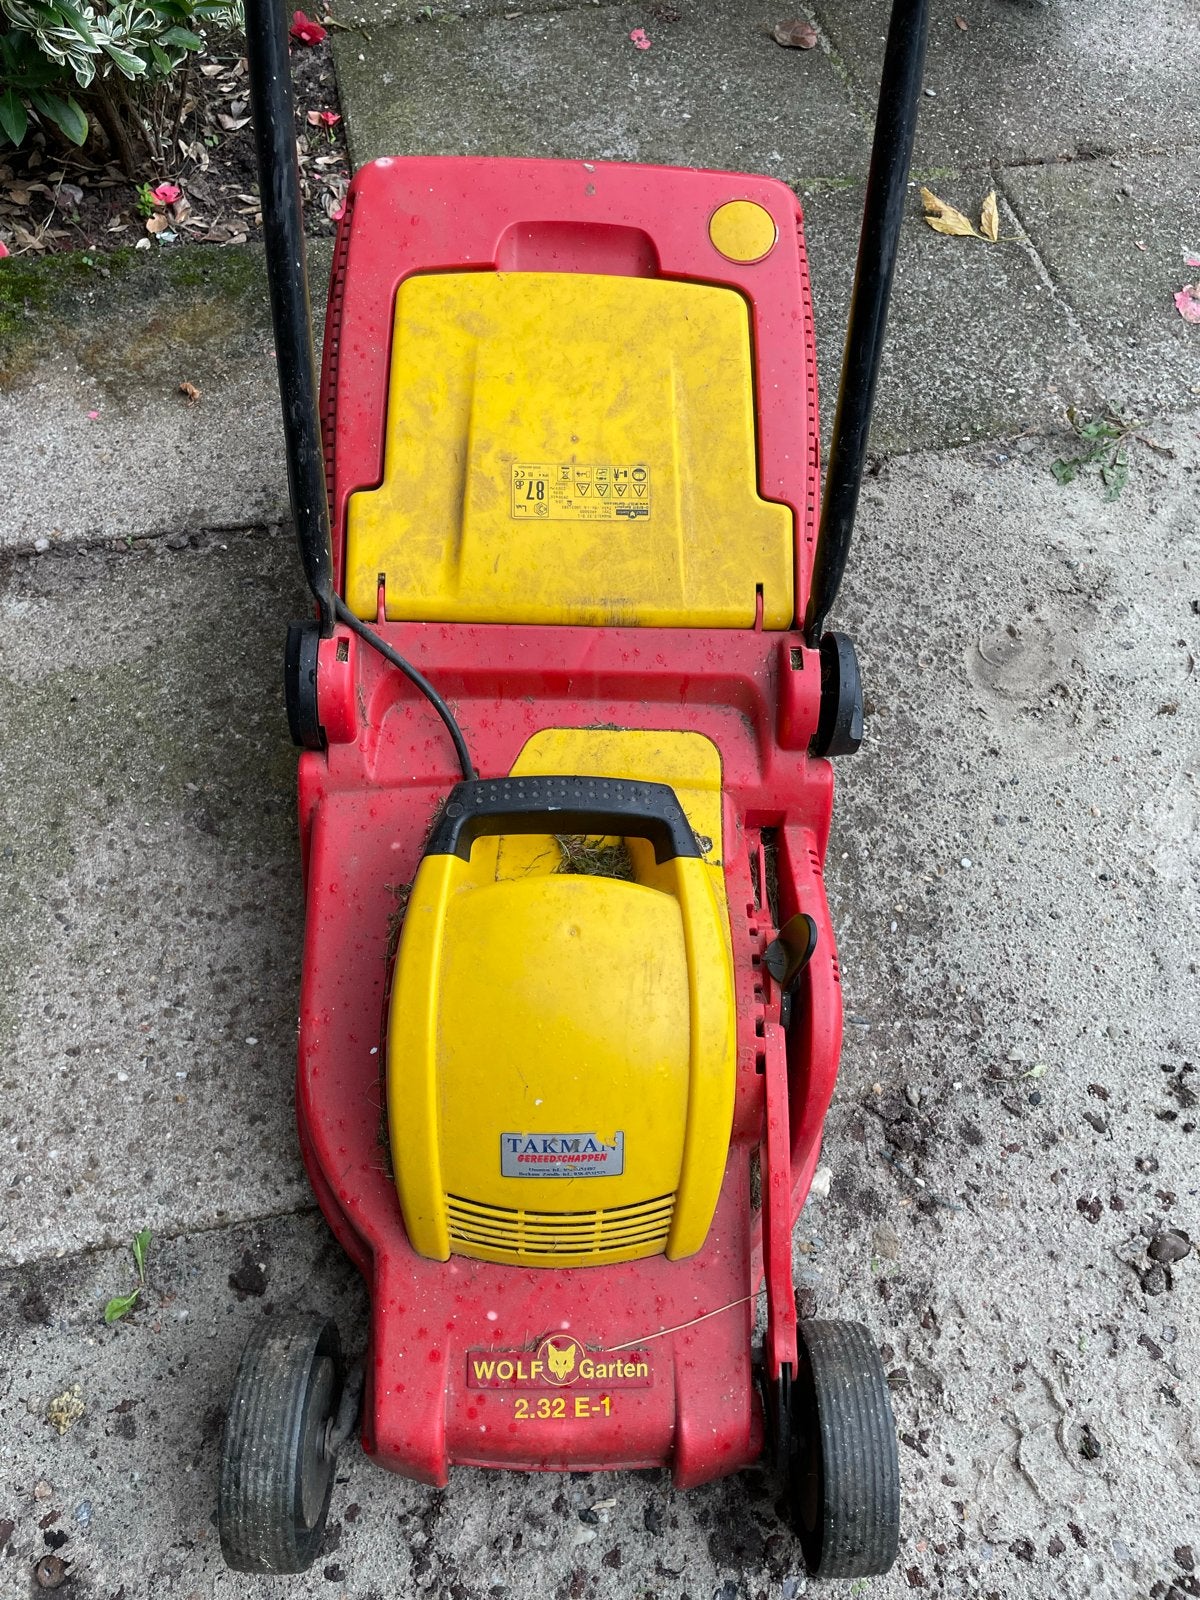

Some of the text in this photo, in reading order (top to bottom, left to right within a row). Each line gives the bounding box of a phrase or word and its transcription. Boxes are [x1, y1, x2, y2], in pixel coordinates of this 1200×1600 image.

[526, 480, 545, 500] 87
[517, 1153, 608, 1163] GEREEDSCHAPPEN
[473, 1358, 648, 1380] WOLF Garten
[514, 1396, 611, 1420] 2.32 E-1
